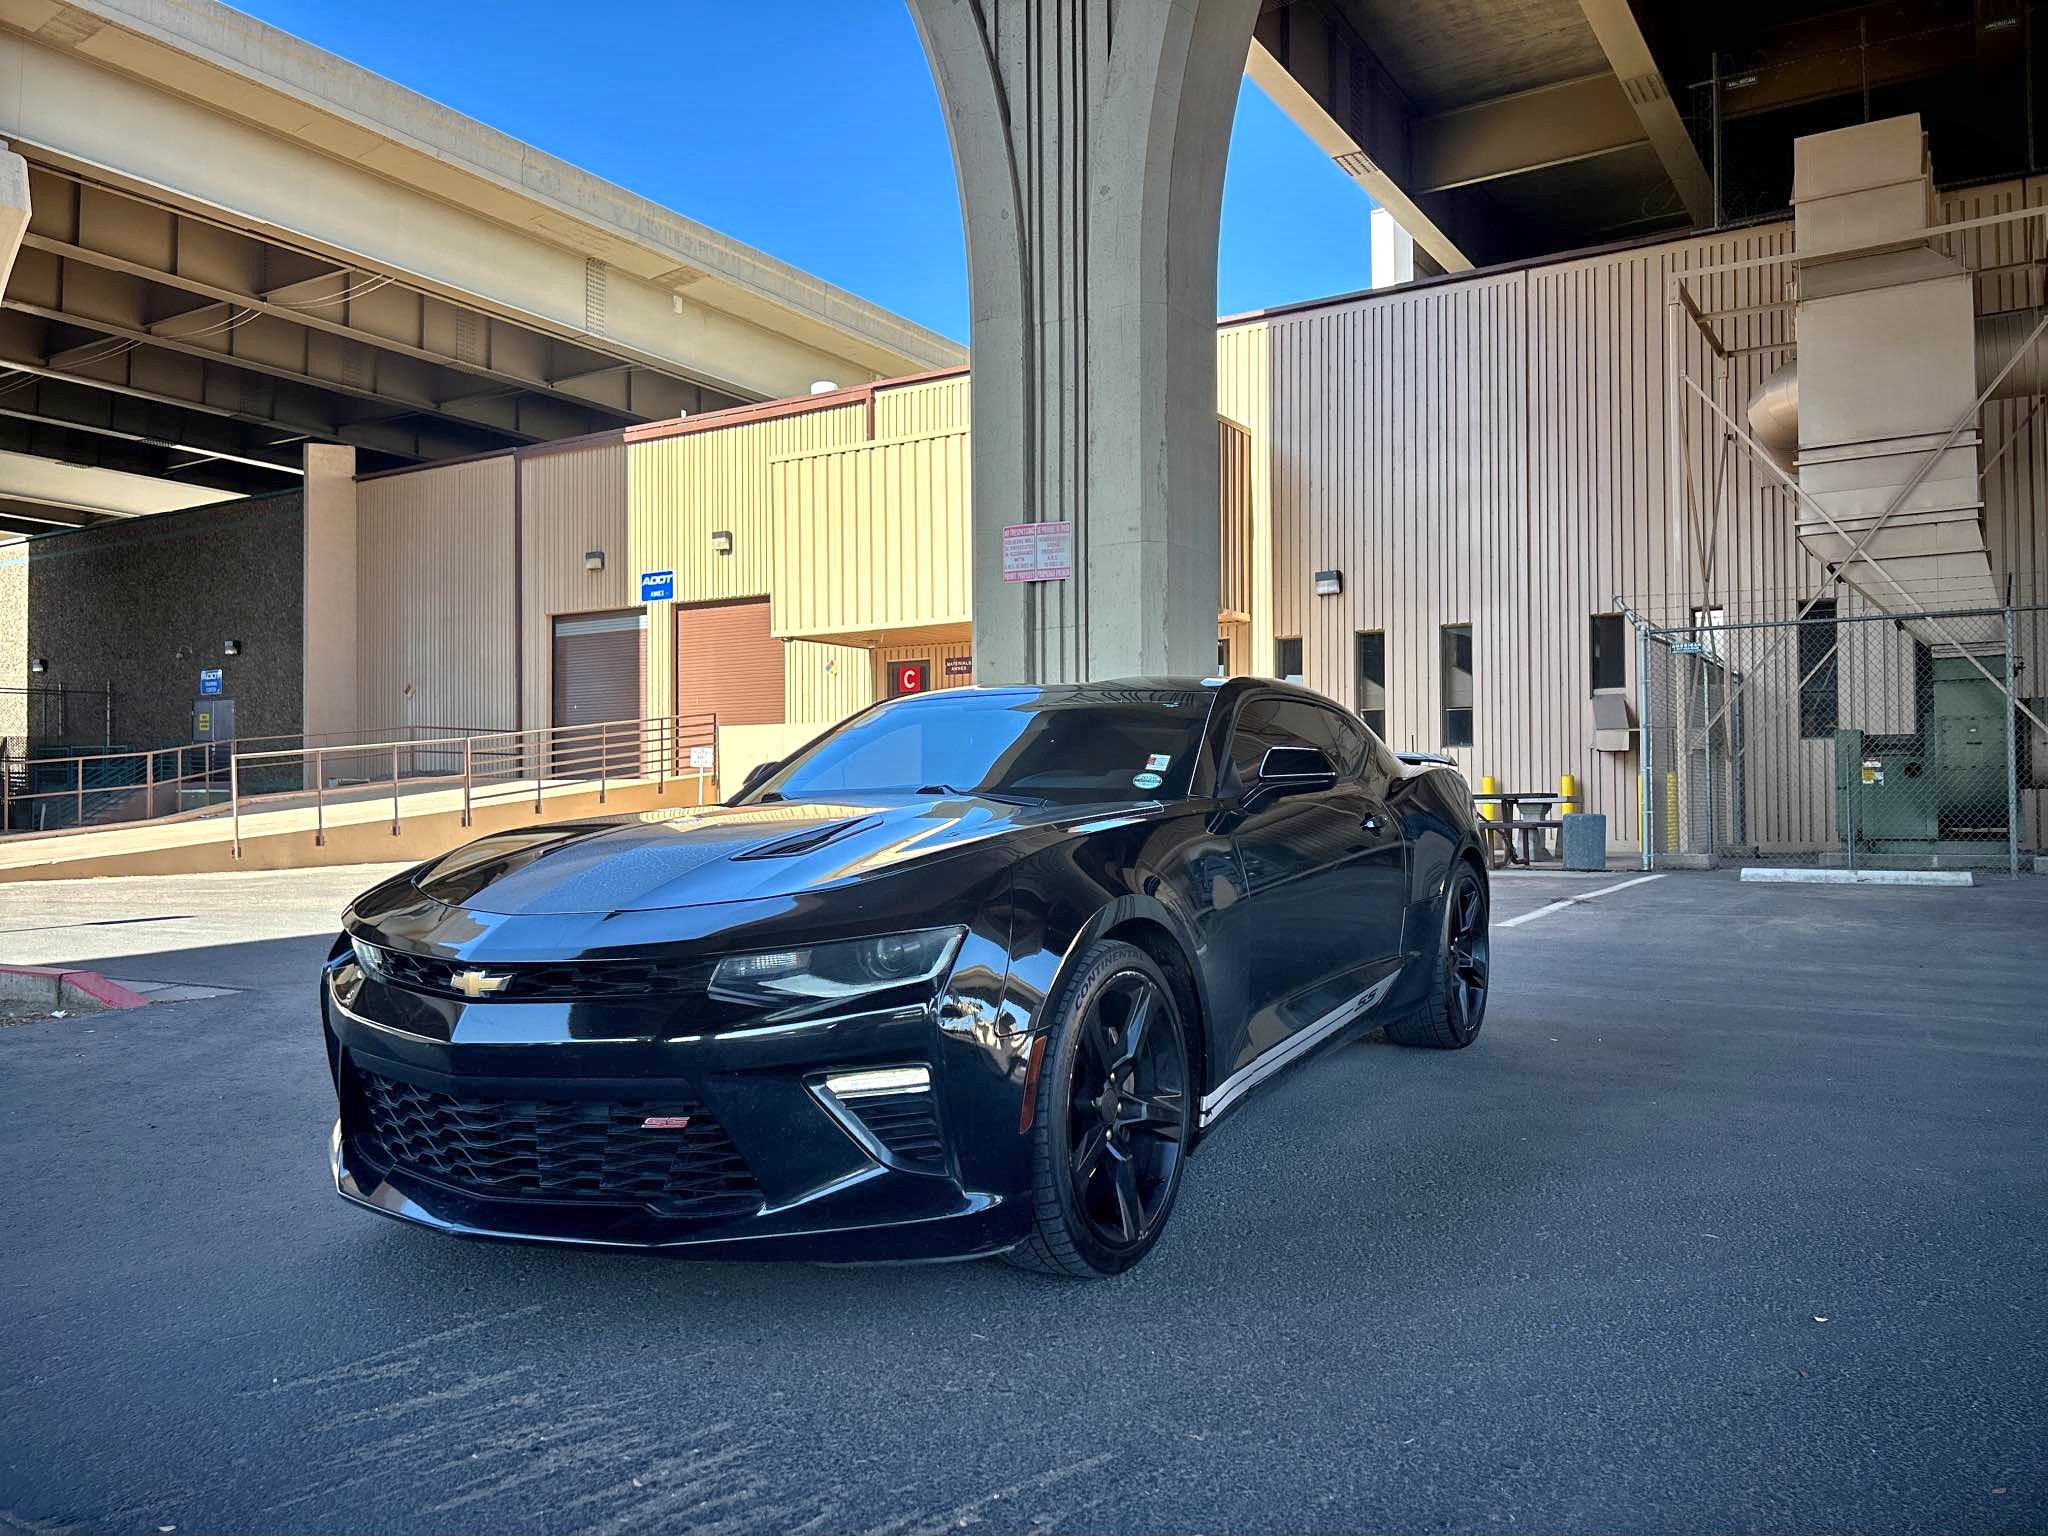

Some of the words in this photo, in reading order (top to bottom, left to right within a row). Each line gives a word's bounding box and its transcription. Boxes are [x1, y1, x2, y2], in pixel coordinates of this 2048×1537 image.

[642, 574, 673, 586] ADOT
[903, 670, 915, 689] C
[1076, 949, 1144, 1010] CONTINENTAL
[1354, 987, 1378, 1012] SS
[641, 1116, 690, 1128] SS
